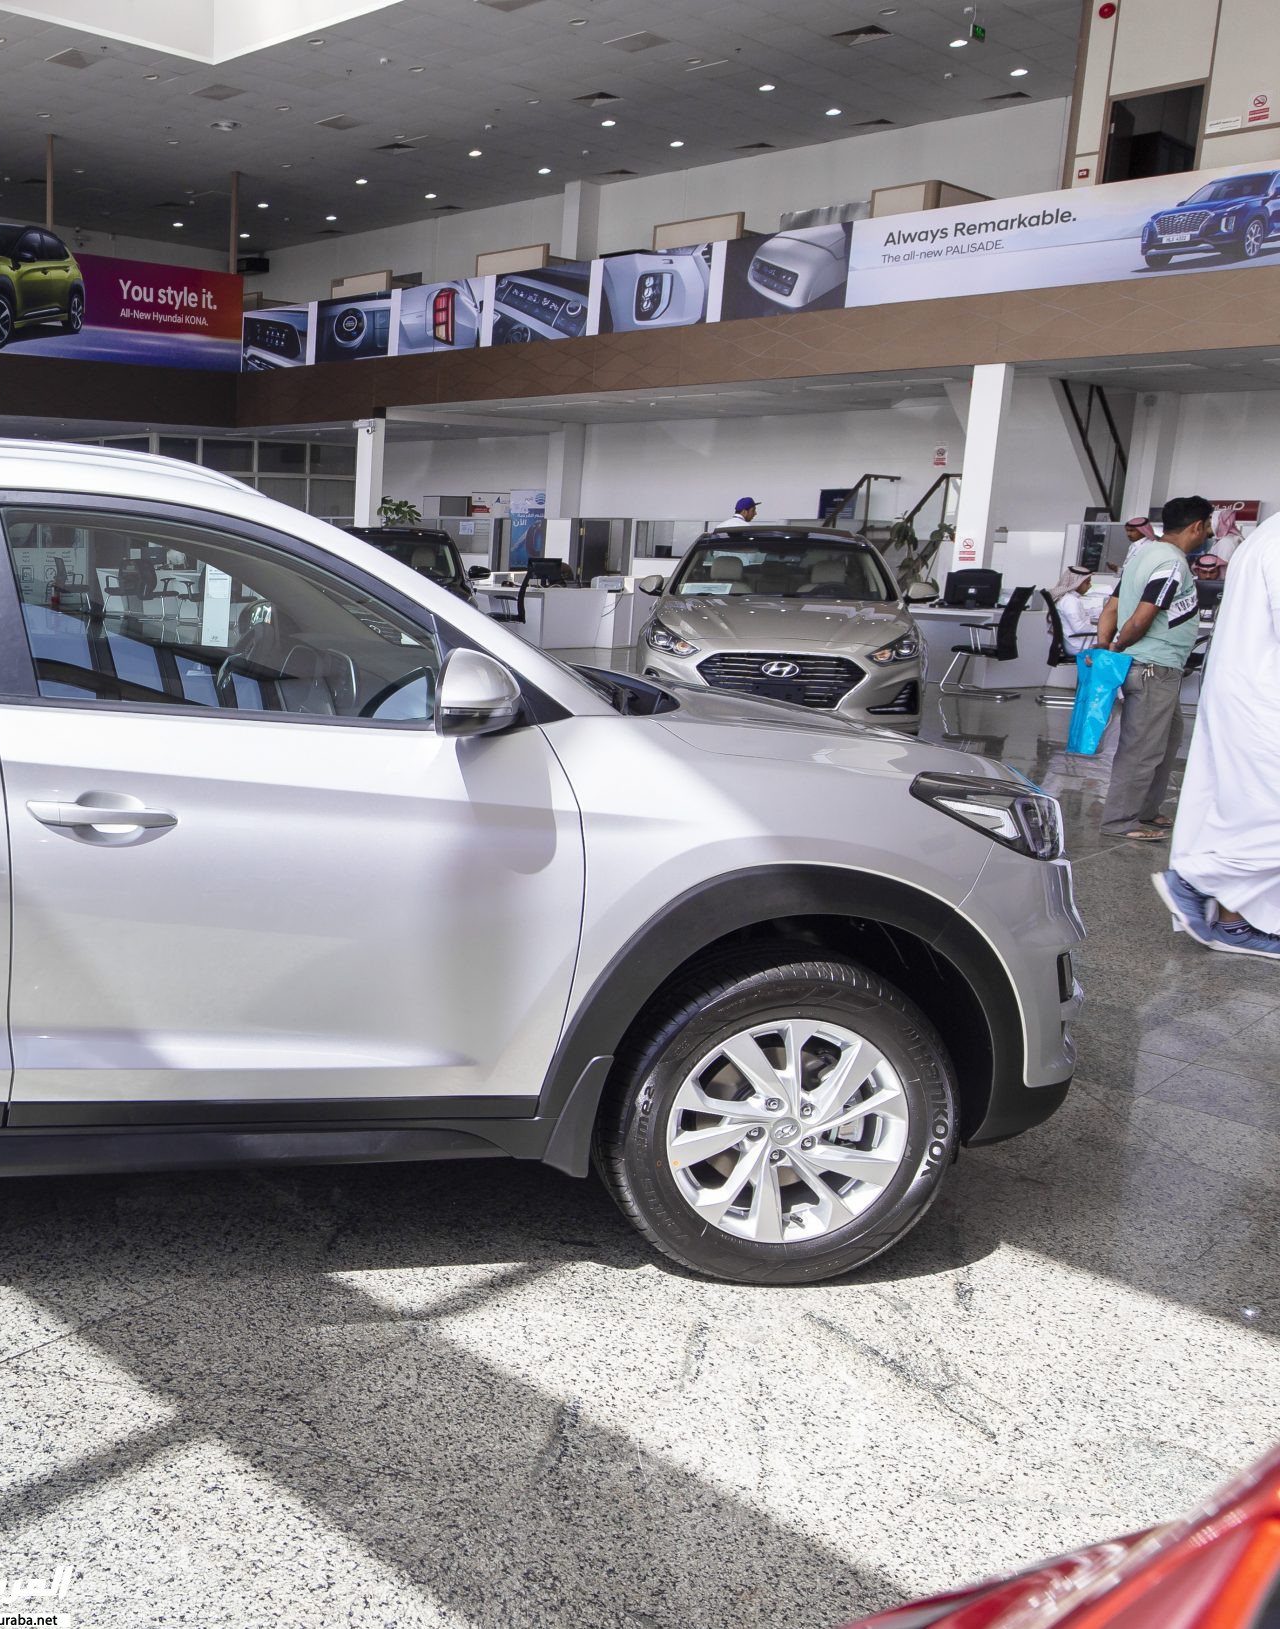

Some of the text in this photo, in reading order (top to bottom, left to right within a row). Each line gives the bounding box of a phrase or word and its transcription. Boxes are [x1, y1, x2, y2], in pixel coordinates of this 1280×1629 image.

[883, 208, 1077, 247] Always Remarkable.
[881, 239, 1005, 264] The all-new PALISADE.
[118, 279, 218, 310] You style it.
[120, 308, 209, 326] All-New Hyundai KONA.
